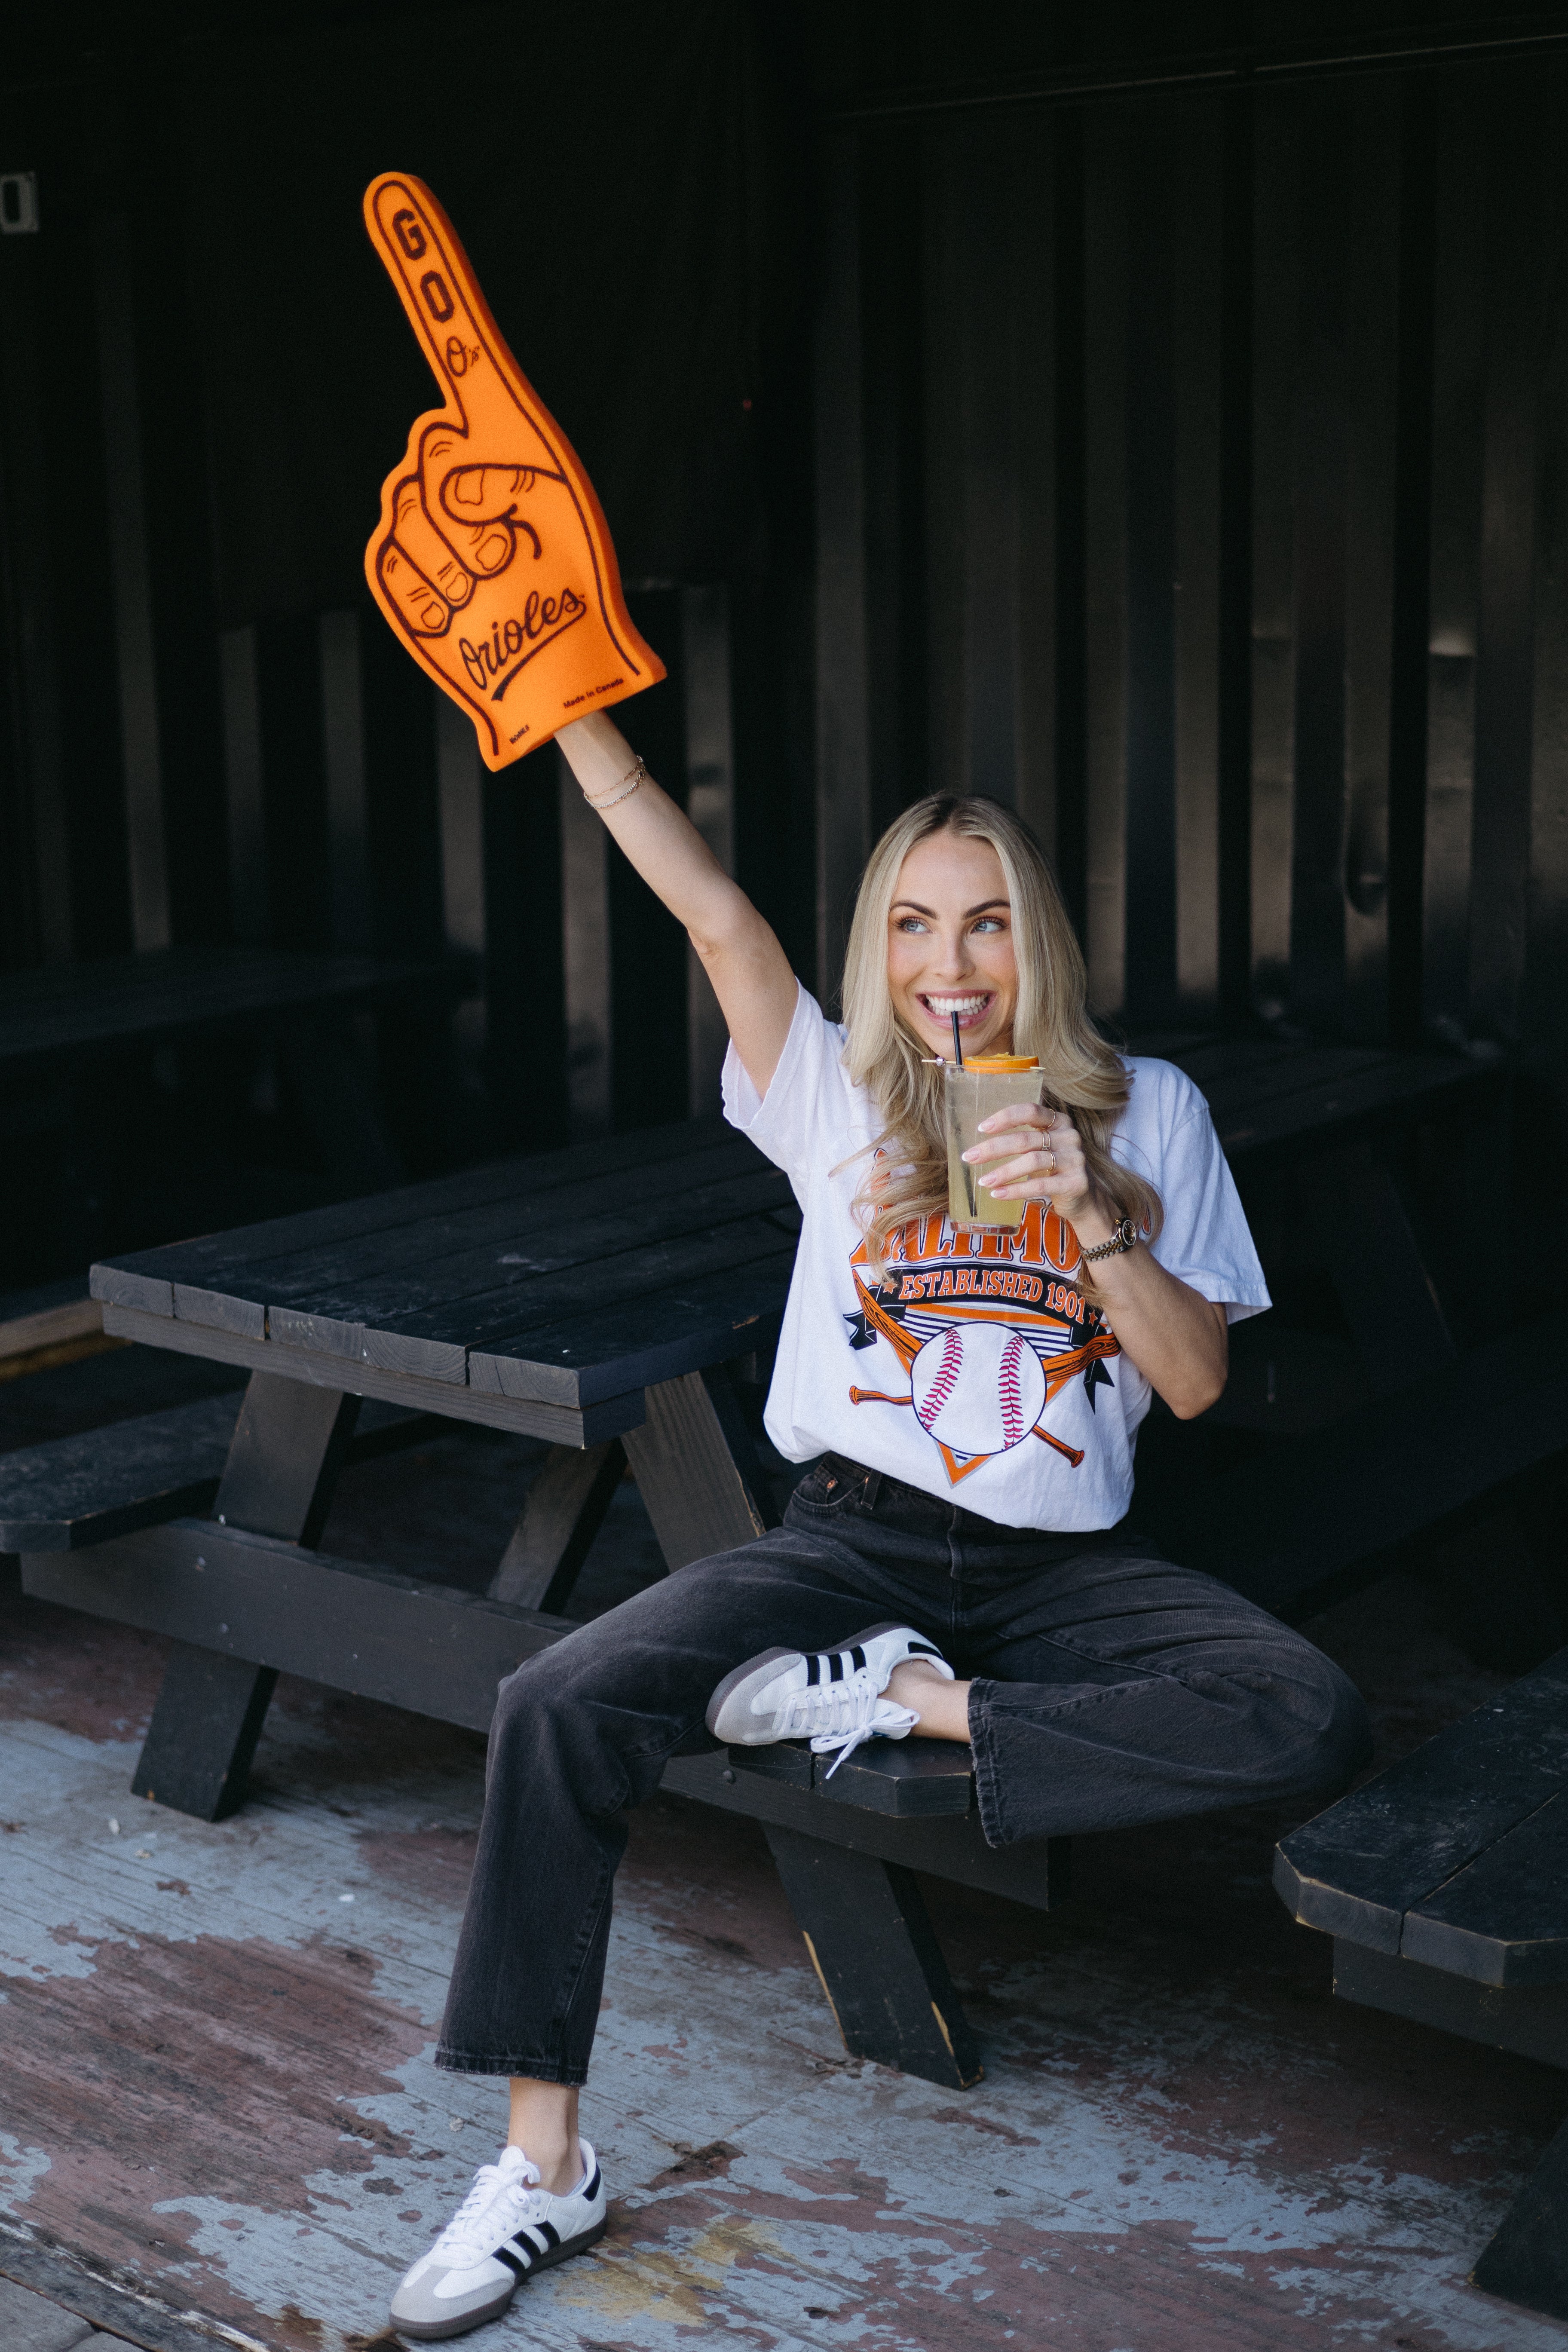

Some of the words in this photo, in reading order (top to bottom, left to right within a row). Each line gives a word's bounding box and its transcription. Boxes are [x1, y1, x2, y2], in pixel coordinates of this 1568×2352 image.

[459, 588, 587, 690] Orioles
[564, 695, 585, 708] Made
[596, 678, 623, 693] Canada
[899, 1269, 1043, 1302] ESTABLISHED
[1045, 1282, 1085, 1324] 1901
